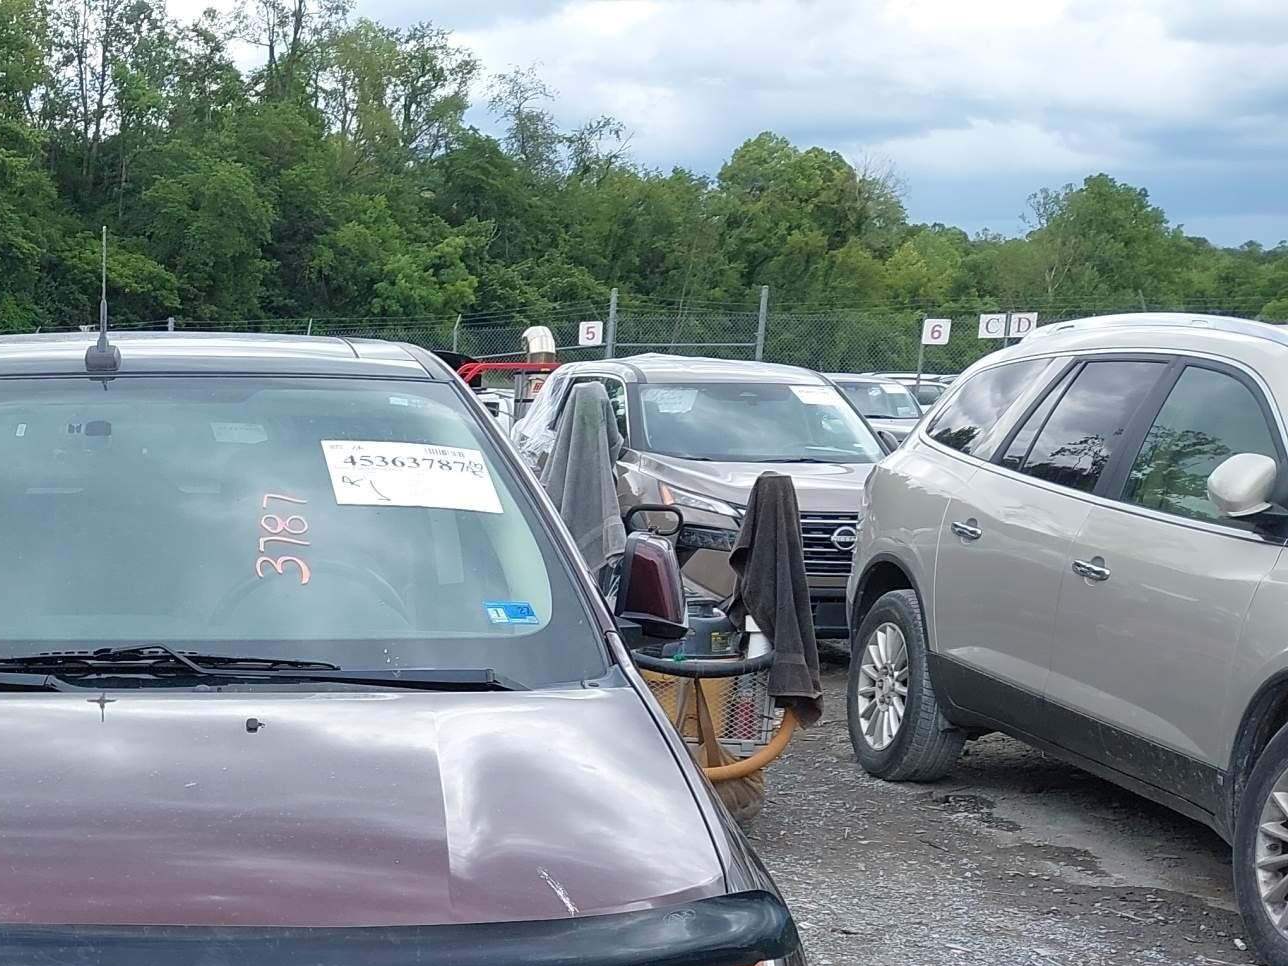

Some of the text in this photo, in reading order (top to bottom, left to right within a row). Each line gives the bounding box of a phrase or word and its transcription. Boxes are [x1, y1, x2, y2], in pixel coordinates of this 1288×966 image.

[930, 324, 943, 340] 6
[985, 318, 1000, 334] C
[1016, 317, 1032, 333] D
[585, 326, 596, 341] 5
[343, 455, 465, 472] 45363787
[255, 493, 311, 585] 3787
